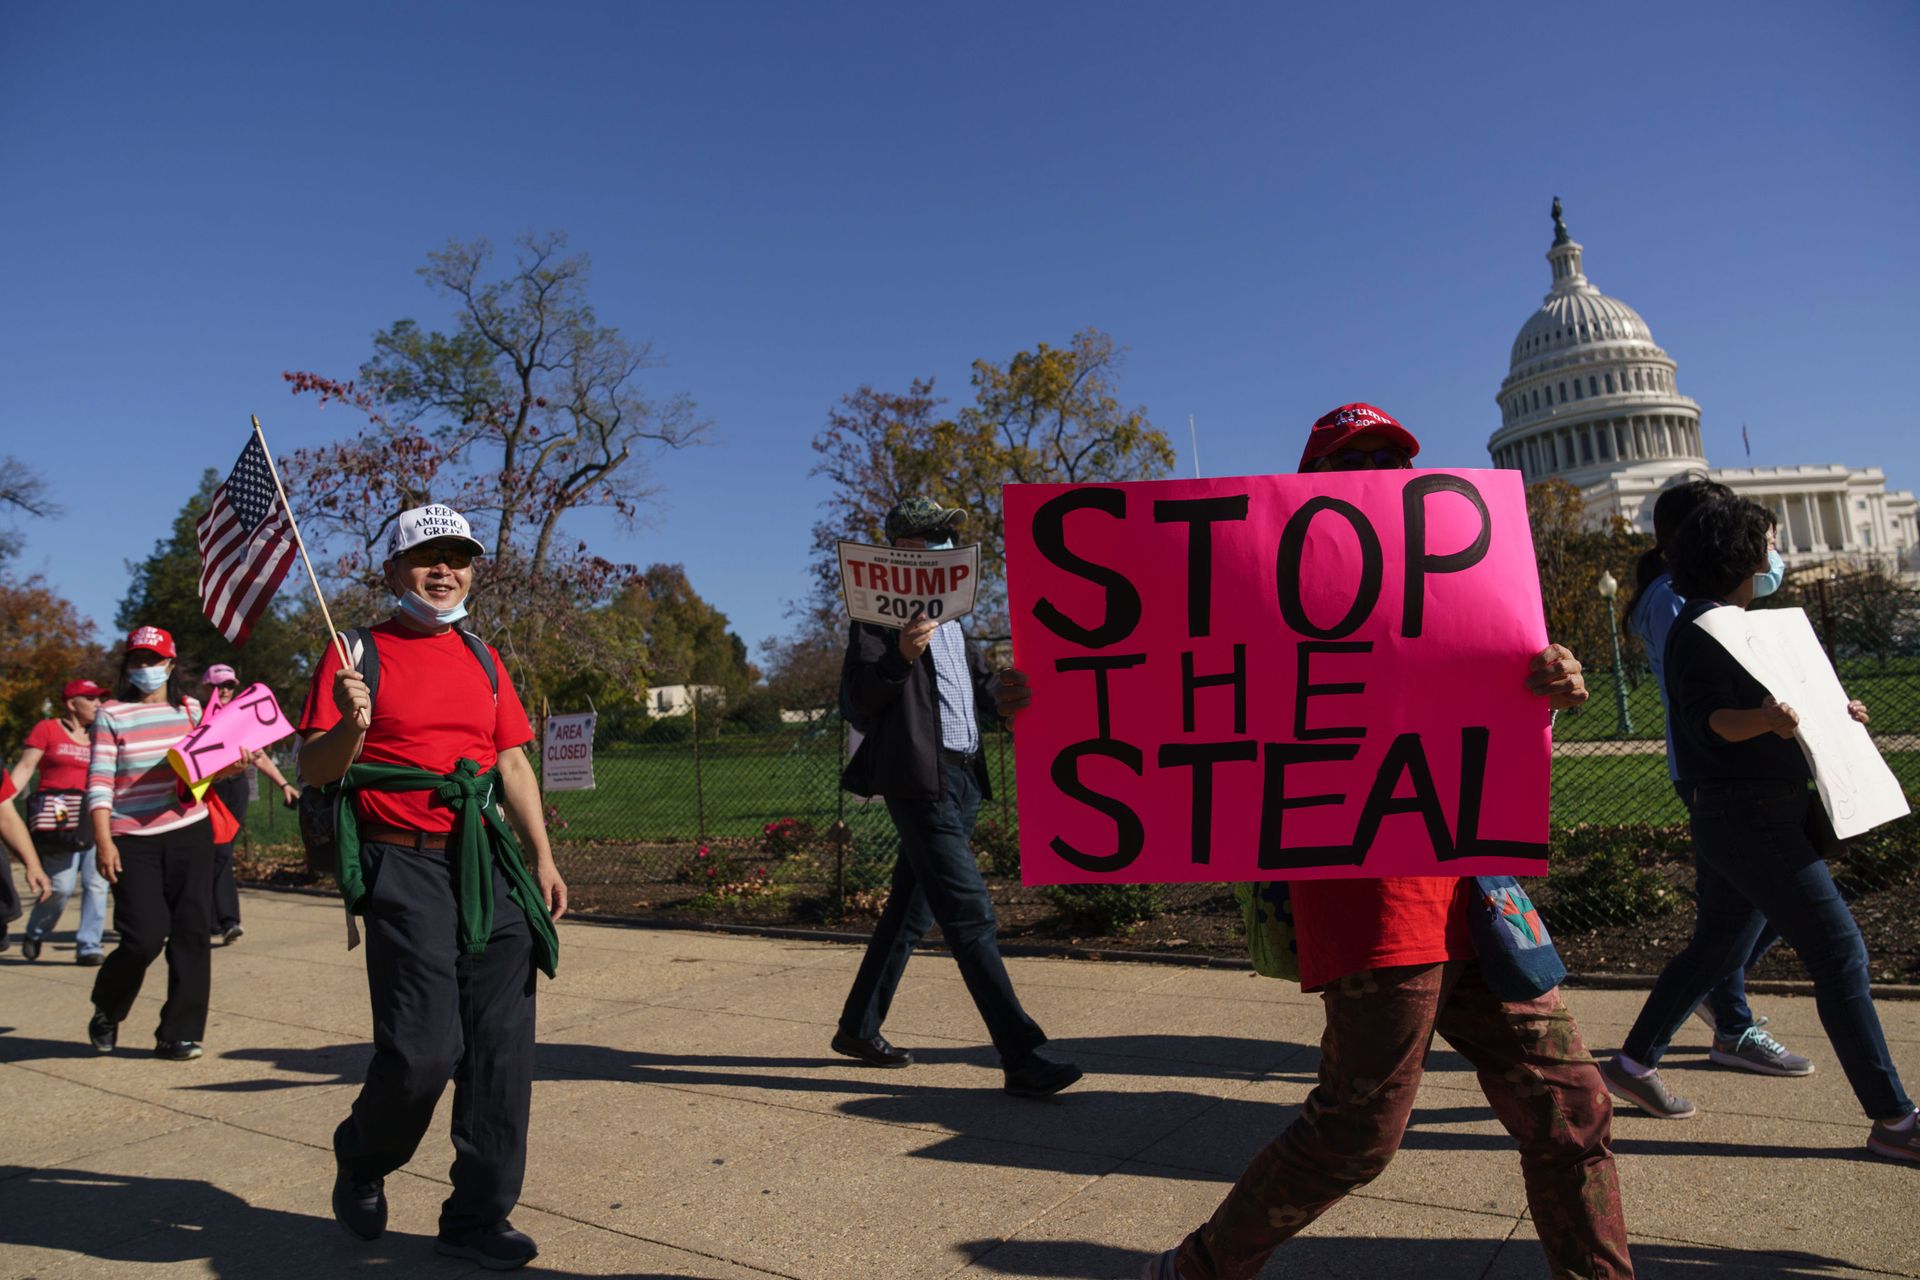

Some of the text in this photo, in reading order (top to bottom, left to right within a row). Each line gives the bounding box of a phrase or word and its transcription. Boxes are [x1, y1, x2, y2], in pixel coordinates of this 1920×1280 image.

[425, 507, 455, 517] KEEP
[1032, 474, 1491, 649] STOP
[847, 559, 969, 596] TRUMP
[875, 595, 943, 621] 2020
[1054, 641, 1374, 741] THE
[555, 724, 583, 741] AREA
[547, 743, 588, 761] CLOSED
[1049, 726, 1548, 873] STEAL
